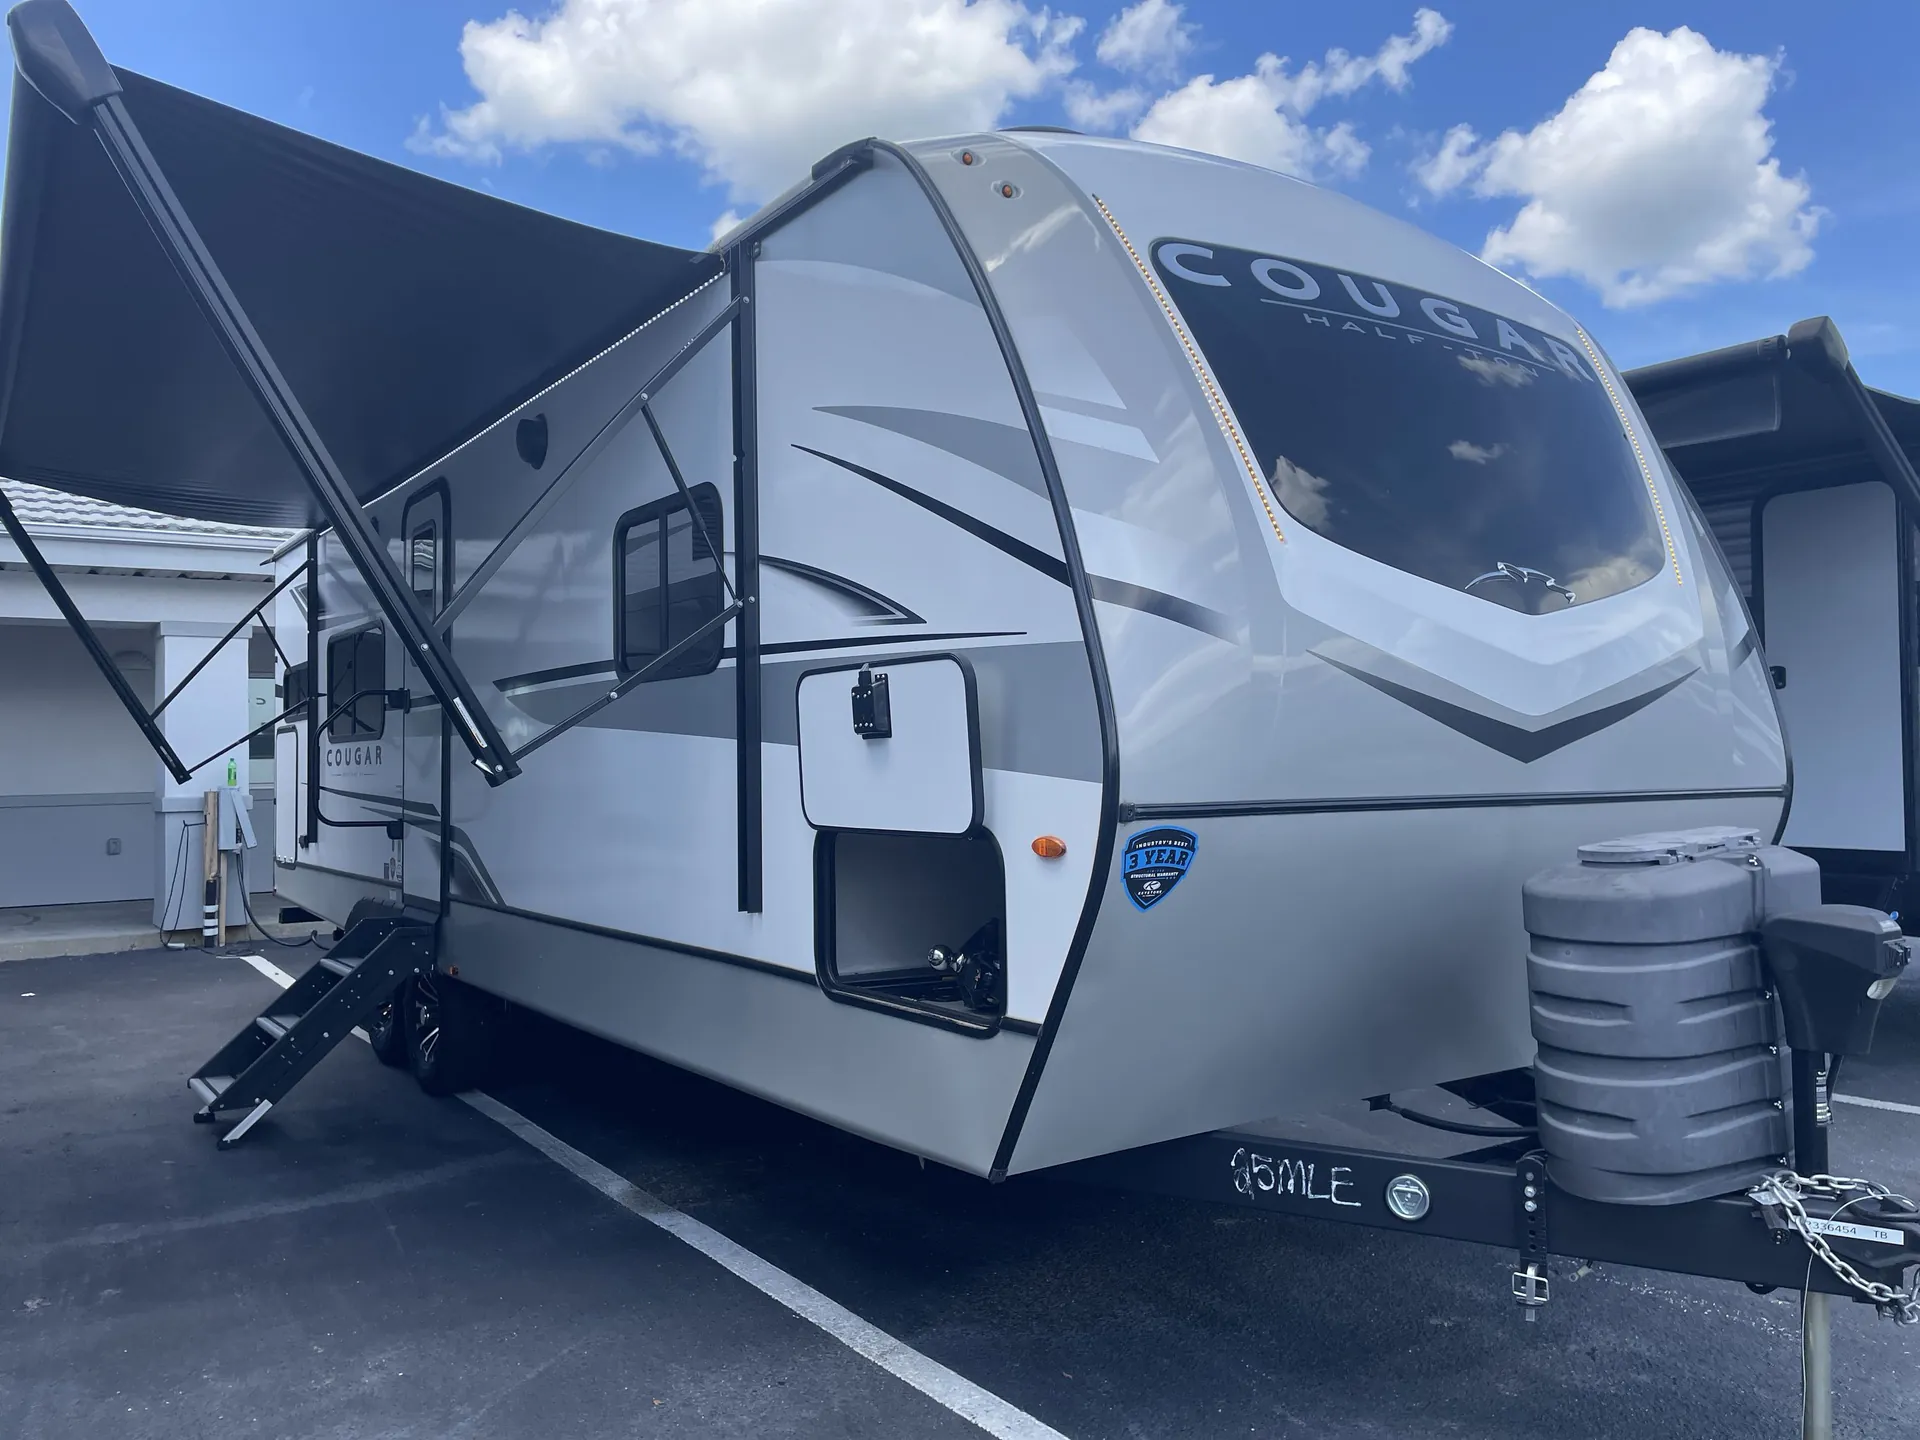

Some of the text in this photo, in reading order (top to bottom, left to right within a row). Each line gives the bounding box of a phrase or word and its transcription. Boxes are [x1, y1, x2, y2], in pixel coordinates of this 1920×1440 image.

[1157, 242, 1594, 382] COUGAR
[326, 745, 382, 767] COUGAR
[1129, 849, 1188, 870] 3 YEAR
[1873, 1230, 1888, 1240] TB
